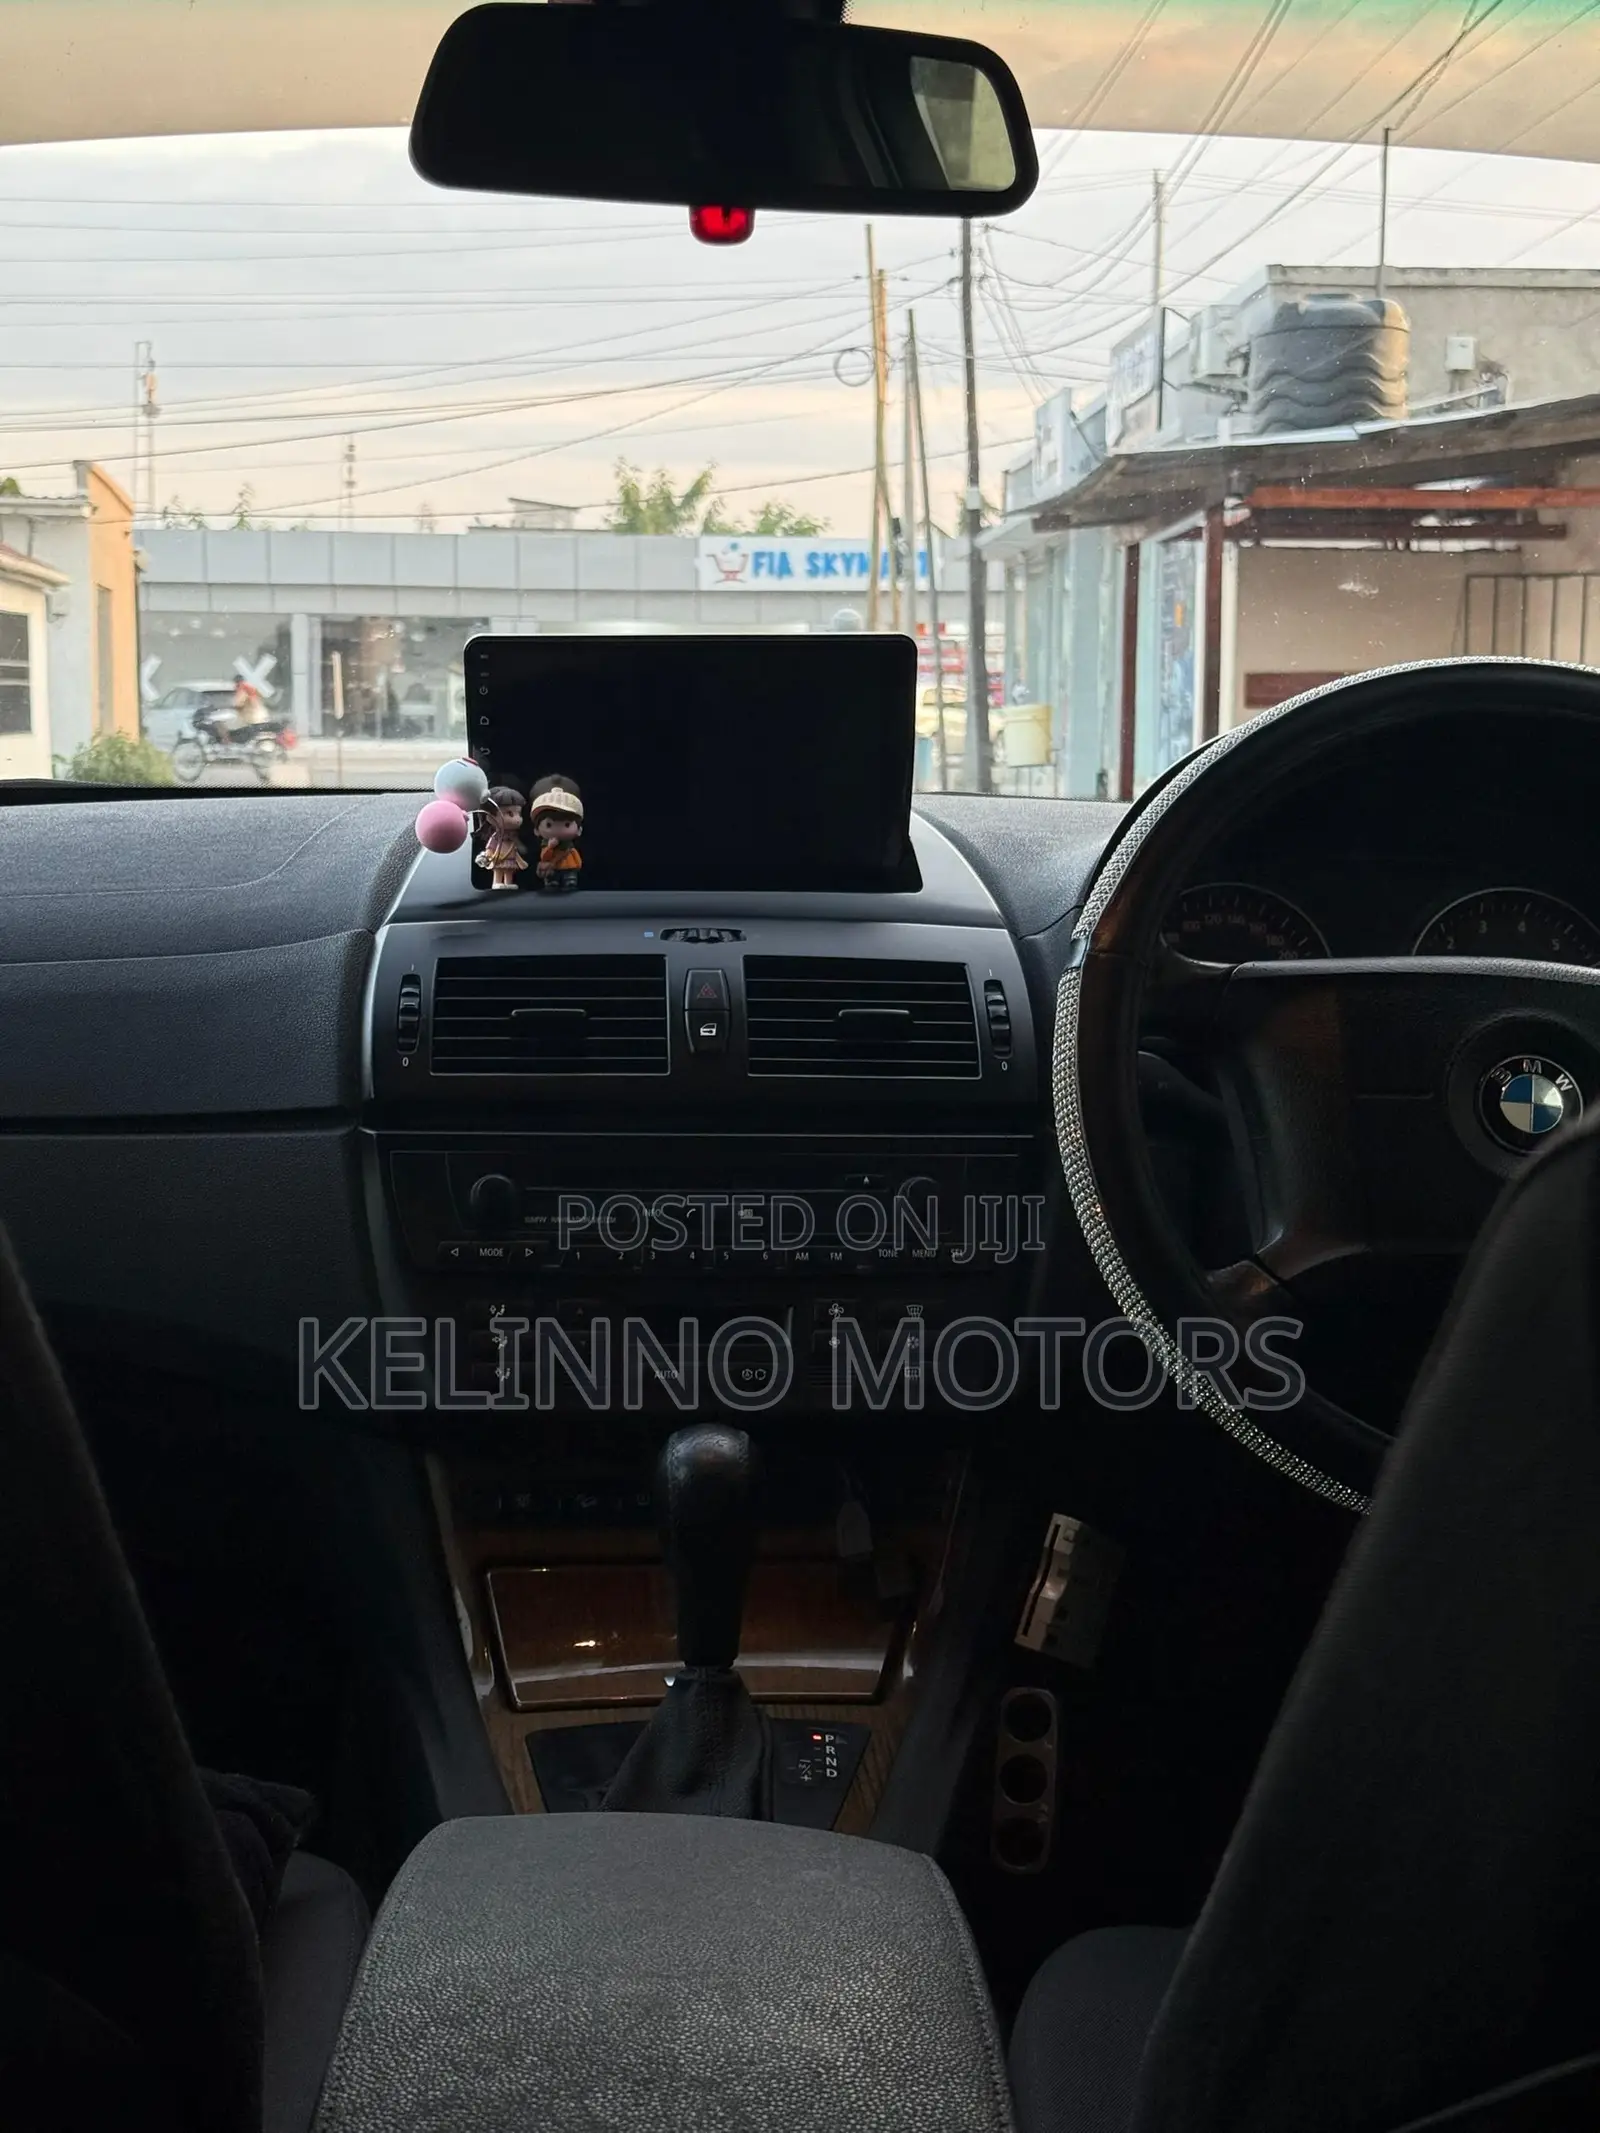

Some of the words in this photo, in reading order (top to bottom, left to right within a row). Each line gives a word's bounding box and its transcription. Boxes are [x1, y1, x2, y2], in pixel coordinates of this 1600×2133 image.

[753, 551, 793, 578] FIA
[1490, 1059, 1573, 1092] BMW
[479, 1248, 504, 1257] MODE
[795, 1252, 809, 1261] AM
[830, 1252, 843, 1261] FM
[878, 1249, 899, 1258] TONE
[912, 1249, 936, 1258] MENU
[825, 1734, 834, 1742] P
[826, 1745, 835, 1755] R
[826, 1757, 837, 1767] N
[826, 1768, 838, 1777] D
